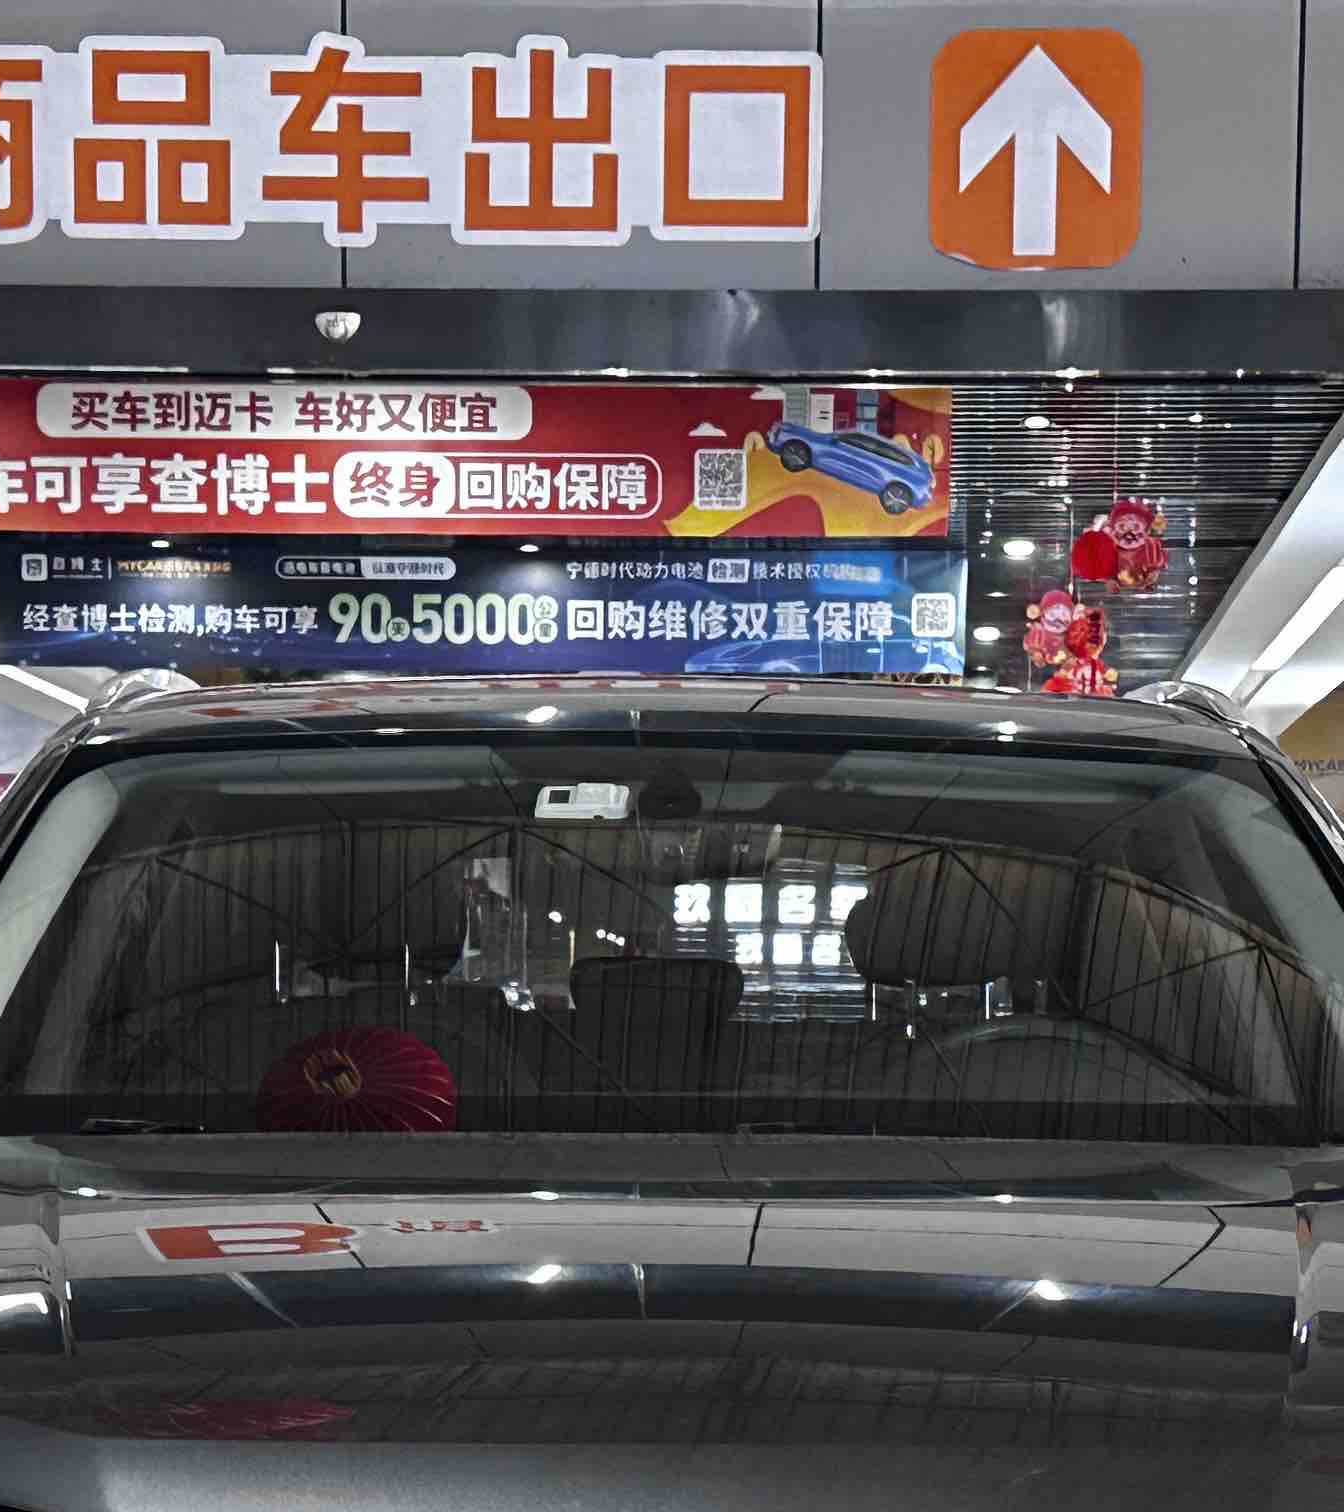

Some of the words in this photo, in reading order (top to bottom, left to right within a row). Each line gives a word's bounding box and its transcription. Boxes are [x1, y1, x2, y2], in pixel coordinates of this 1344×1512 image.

[70, 392, 275, 434] 买车到迈卡
[294, 392, 499, 434] 车好又便宜
[348, 455, 442, 509] 终身
[458, 459, 648, 513] 回购保障
[565, 561, 705, 580] 宁德时代动力电池
[22, 602, 320, 637] 经查博士检测,购车可享
[566, 598, 895, 641] 回购维修双重保障
